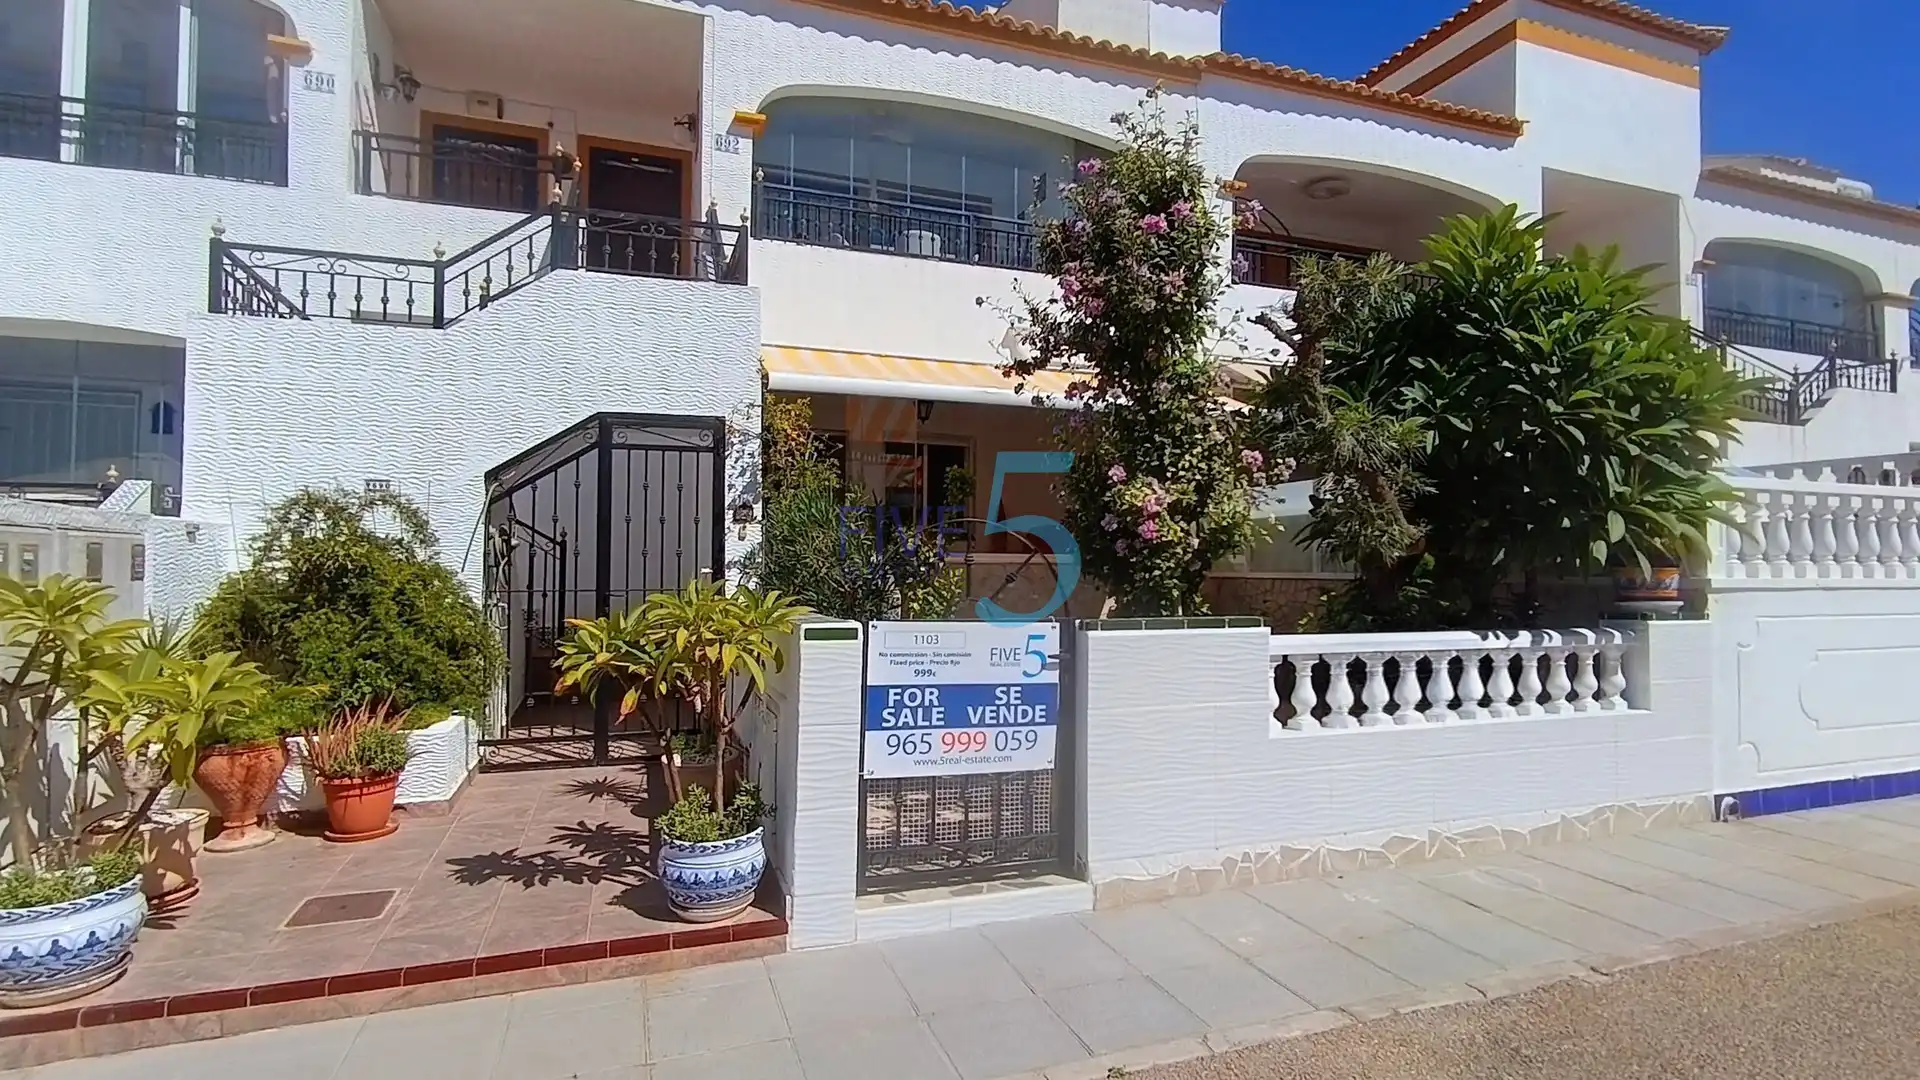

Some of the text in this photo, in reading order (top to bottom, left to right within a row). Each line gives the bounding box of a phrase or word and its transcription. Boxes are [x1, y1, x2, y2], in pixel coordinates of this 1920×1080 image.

[304, 73, 335, 89] 690
[715, 135, 740, 151] 692
[913, 634, 940, 645] 1103
[990, 634, 1048, 678] FIVE 5
[888, 687, 940, 707] FOR
[994, 686, 1022, 705] SE
[881, 707, 945, 727] SALE
[966, 704, 1047, 725] VENDE
[886, 729, 1038, 756] 965 999 059
[913, 755, 1013, 767] www.5real-estate.com
